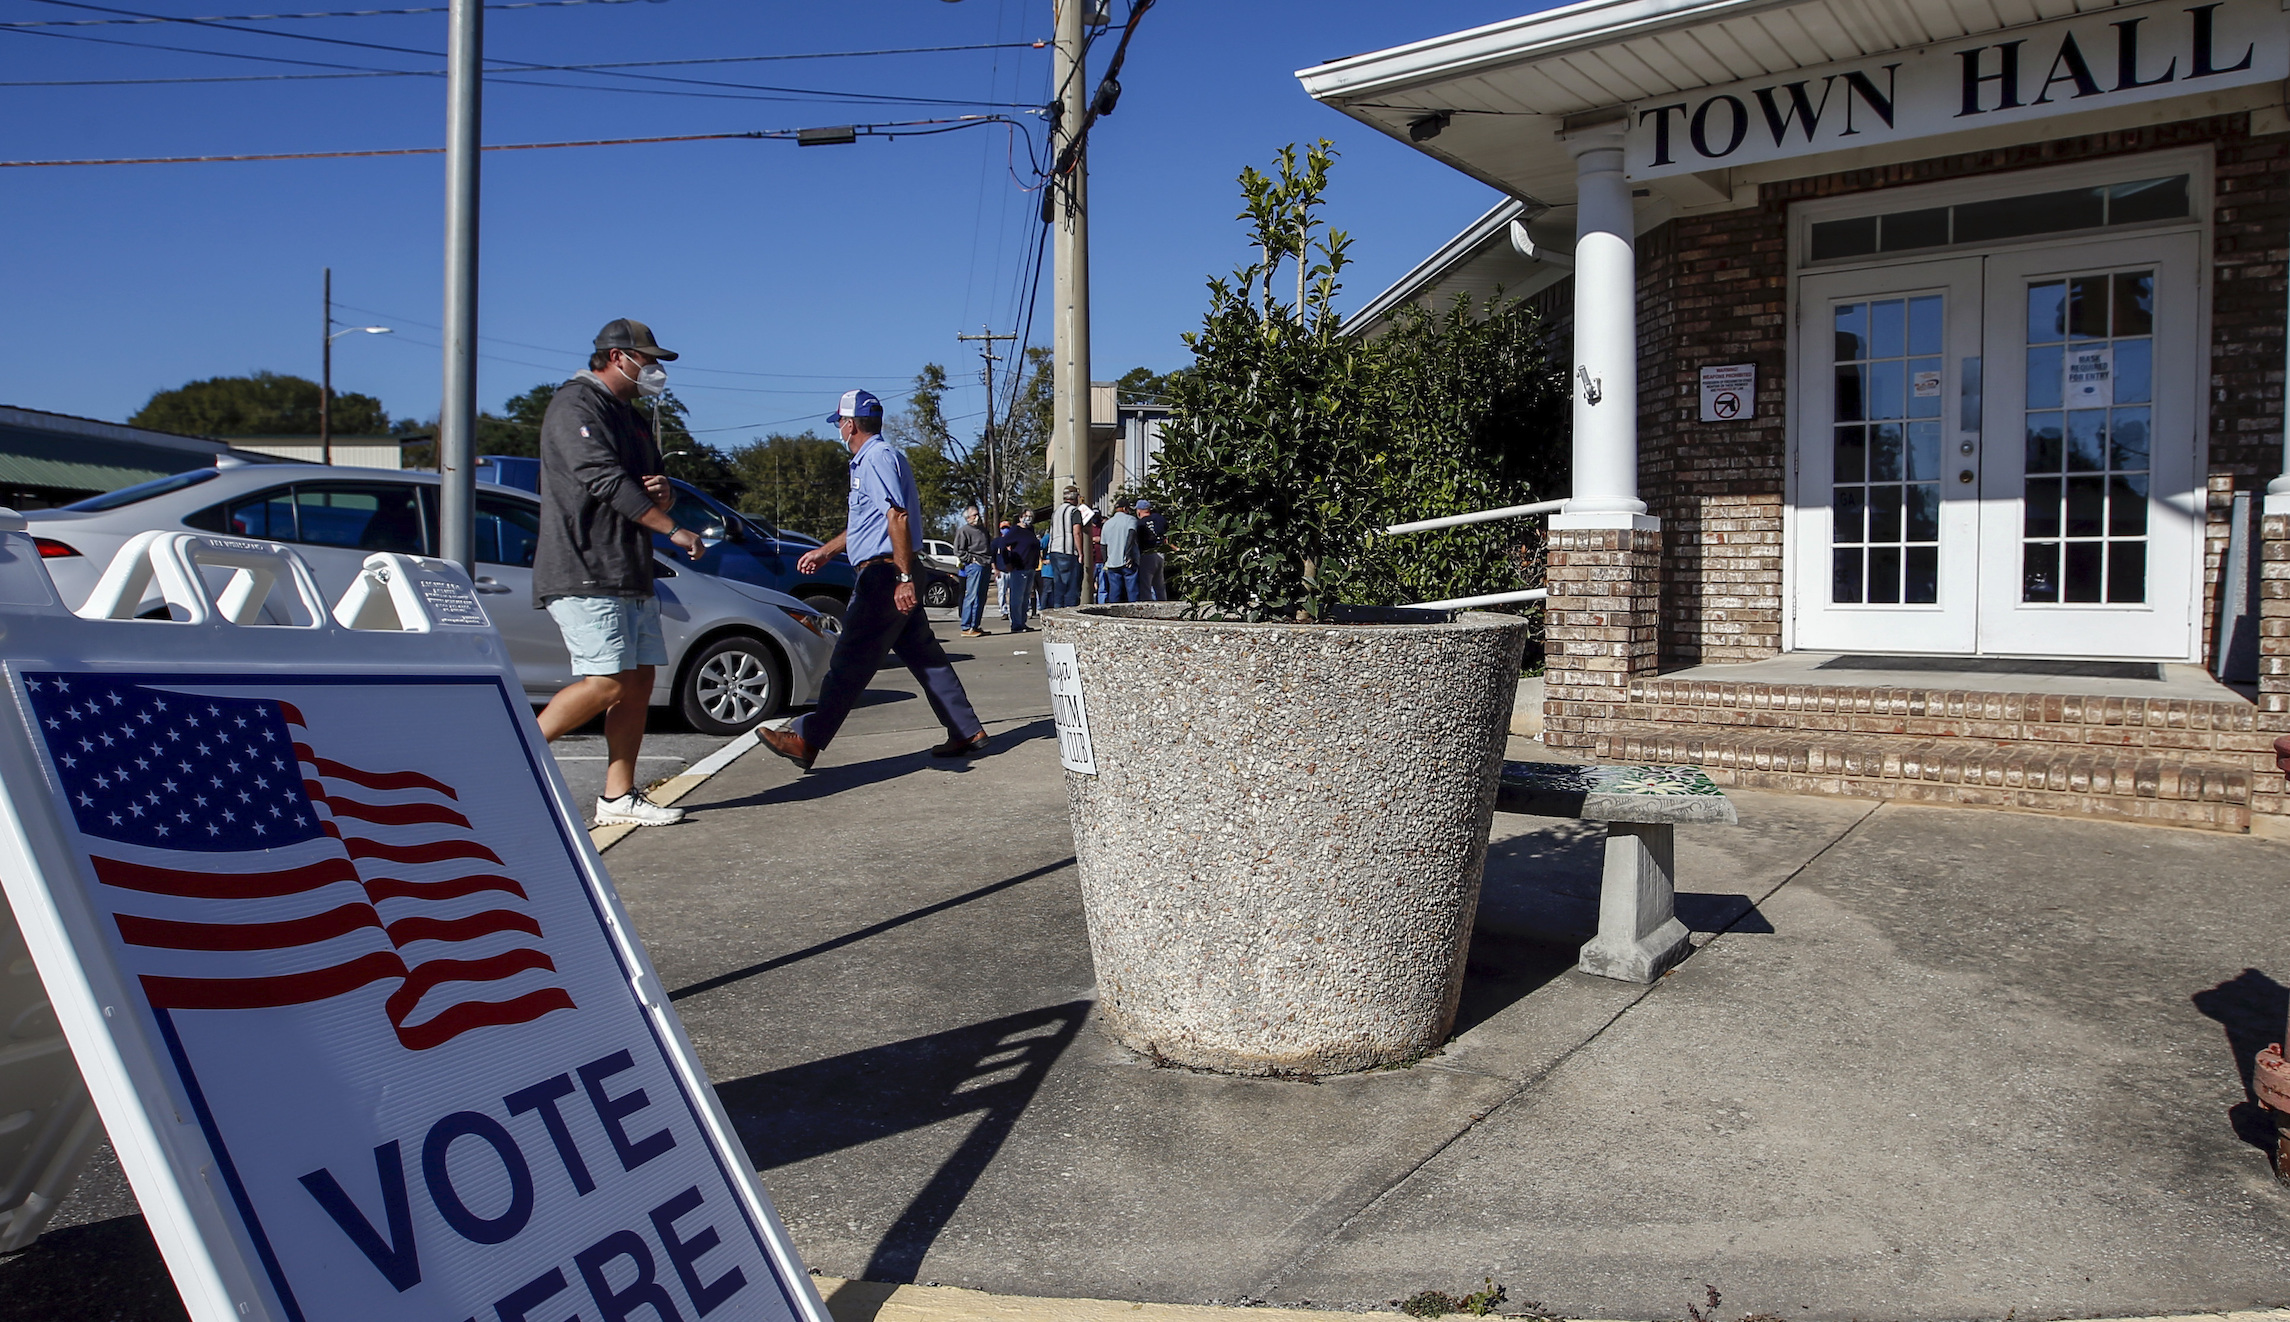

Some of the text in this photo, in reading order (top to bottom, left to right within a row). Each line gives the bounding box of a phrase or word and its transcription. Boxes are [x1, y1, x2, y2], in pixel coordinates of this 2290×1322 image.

[1638, 2, 2256, 169] TOWN HALL
[2069, 371, 2109, 382] FOR ENTRY
[2070, 363, 2108, 372] REQUIRED
[297, 1048, 677, 1293] VOTE
